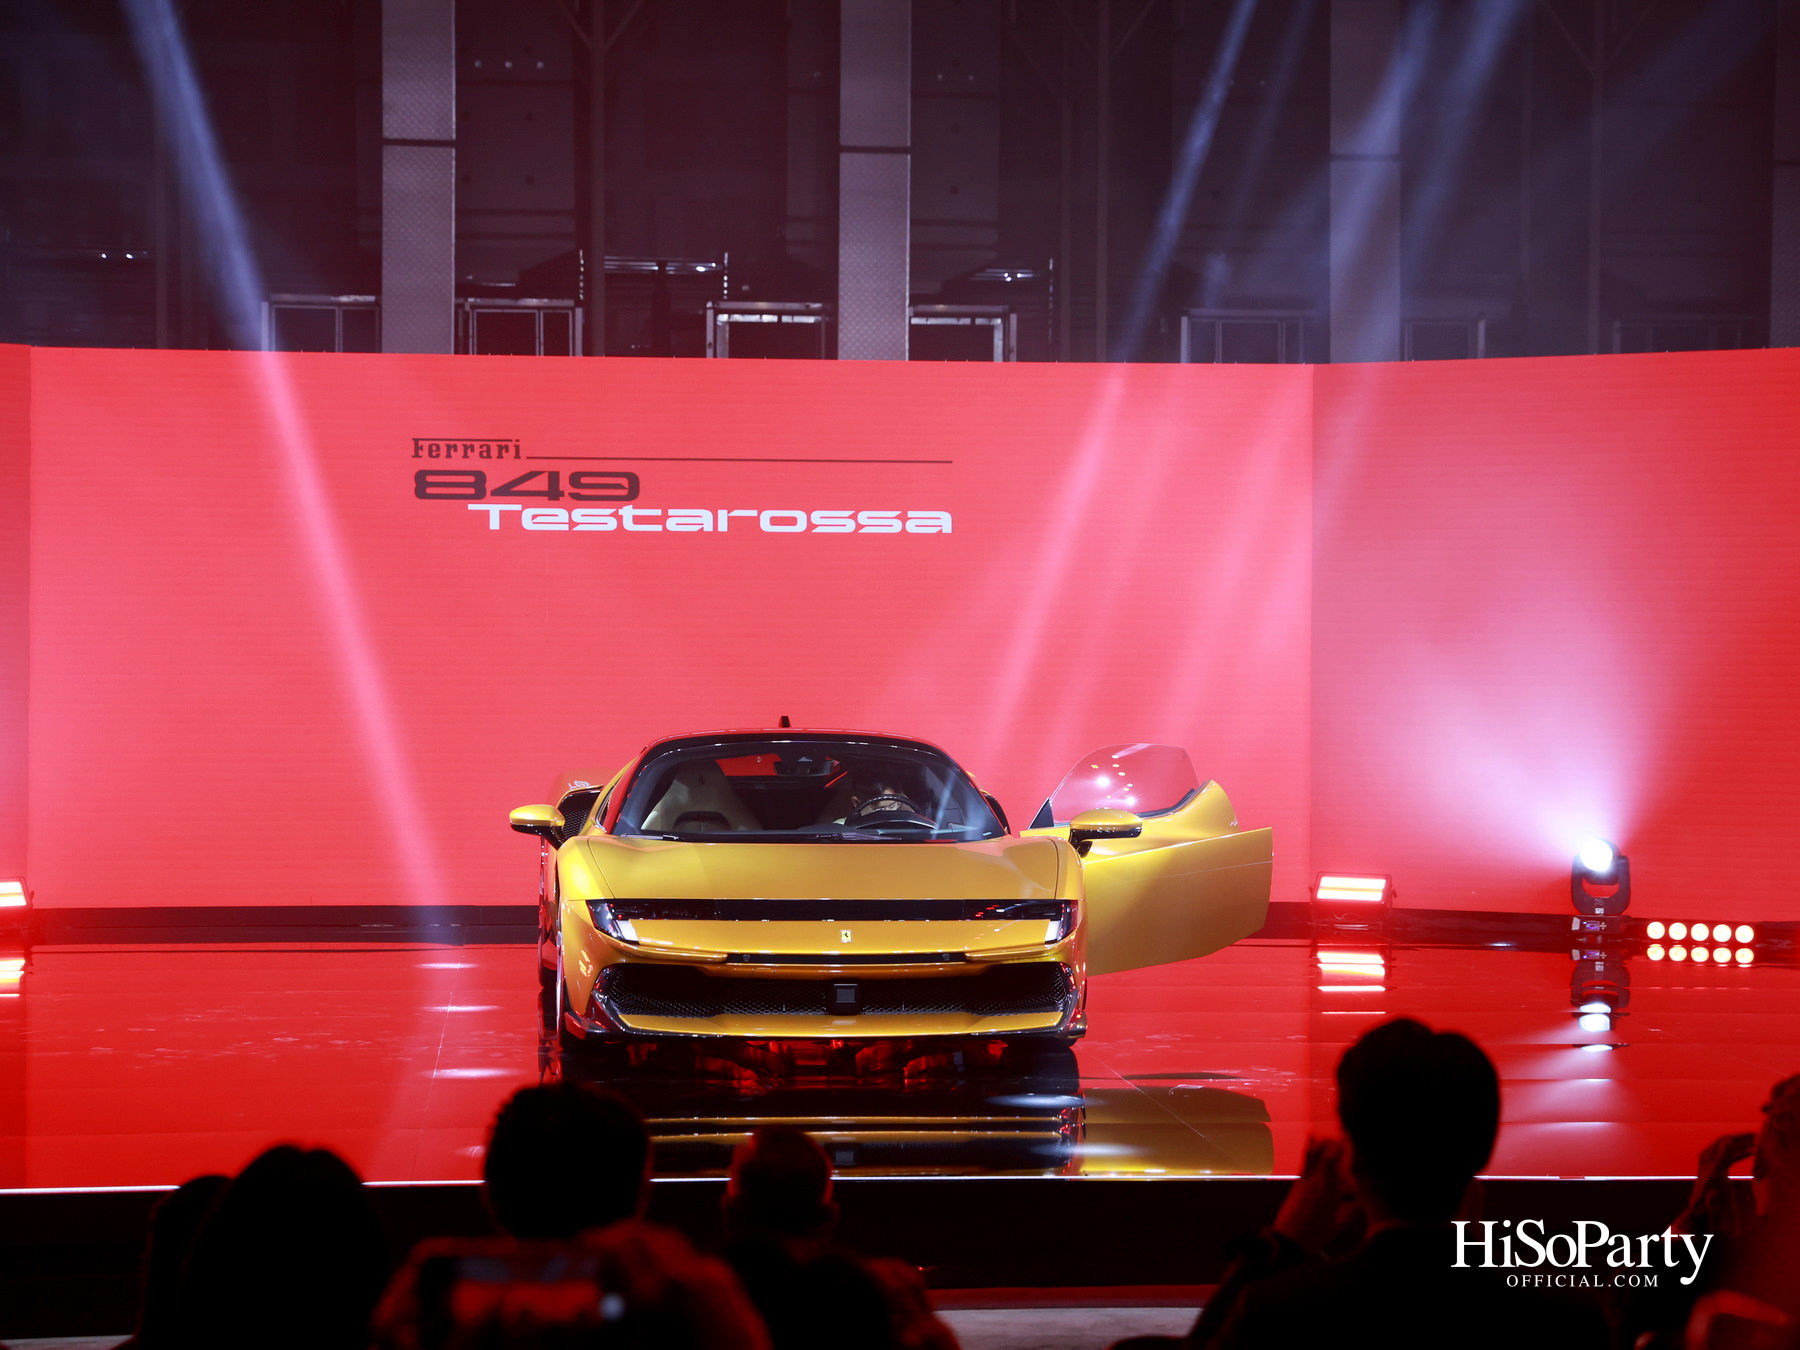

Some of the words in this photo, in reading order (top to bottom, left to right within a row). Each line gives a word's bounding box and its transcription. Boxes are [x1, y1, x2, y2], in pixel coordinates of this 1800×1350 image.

[411, 438, 523, 459] Ferrari
[413, 469, 641, 501] 849
[467, 503, 953, 534] Testarossa
